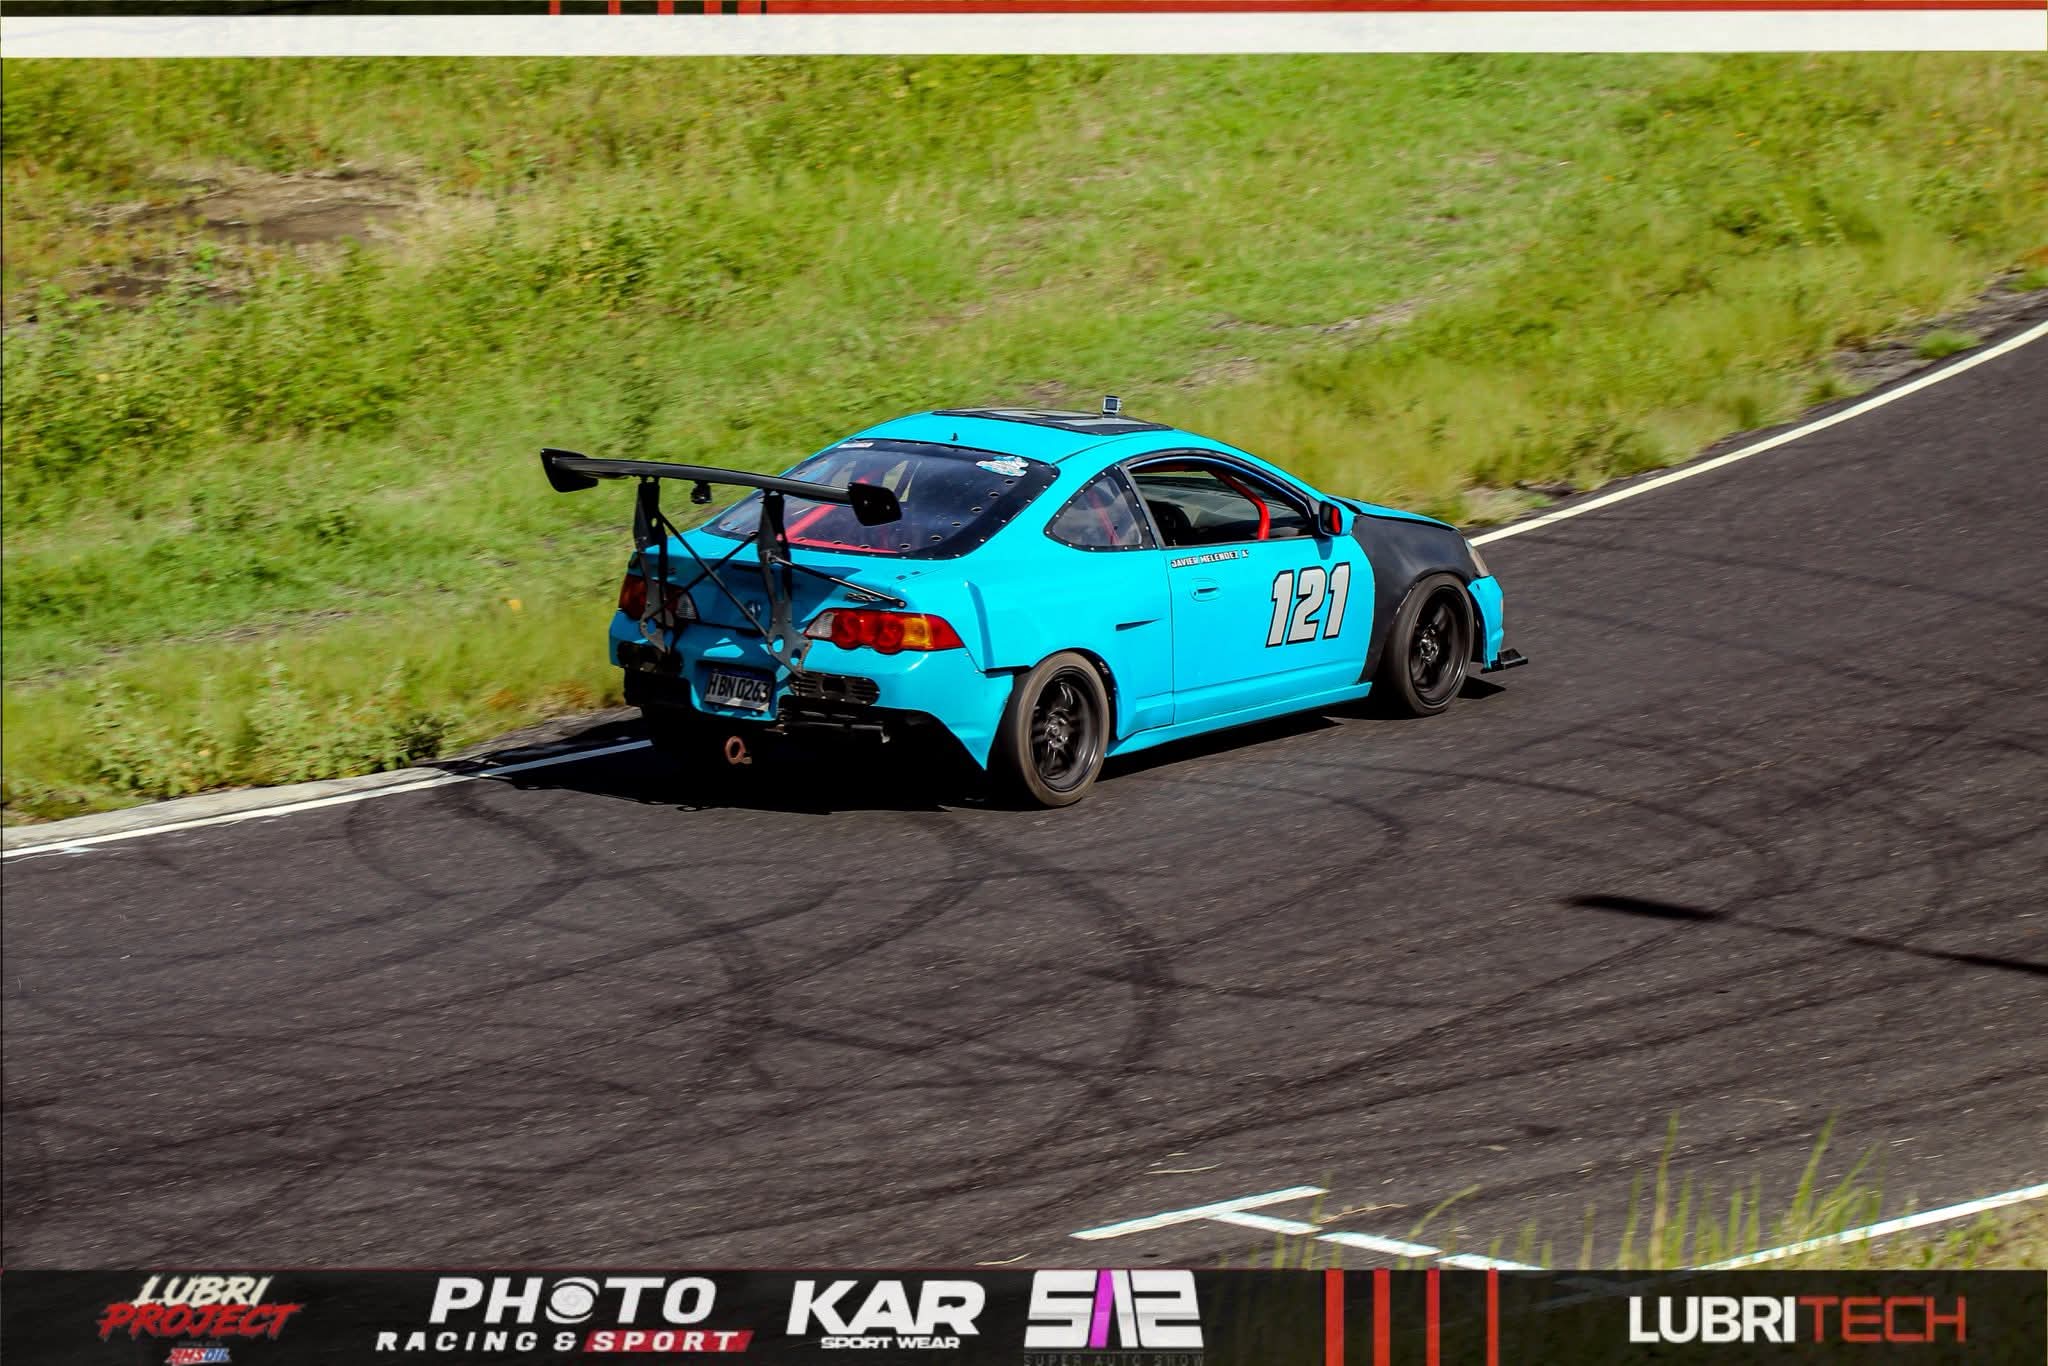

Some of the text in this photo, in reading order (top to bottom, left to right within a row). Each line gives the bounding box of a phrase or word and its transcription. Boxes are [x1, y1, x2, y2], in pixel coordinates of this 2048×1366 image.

[1171, 556, 1199, 569] JAVIER
[1199, 550, 1239, 564] MELENDEZ
[1265, 562, 1350, 648] 121
